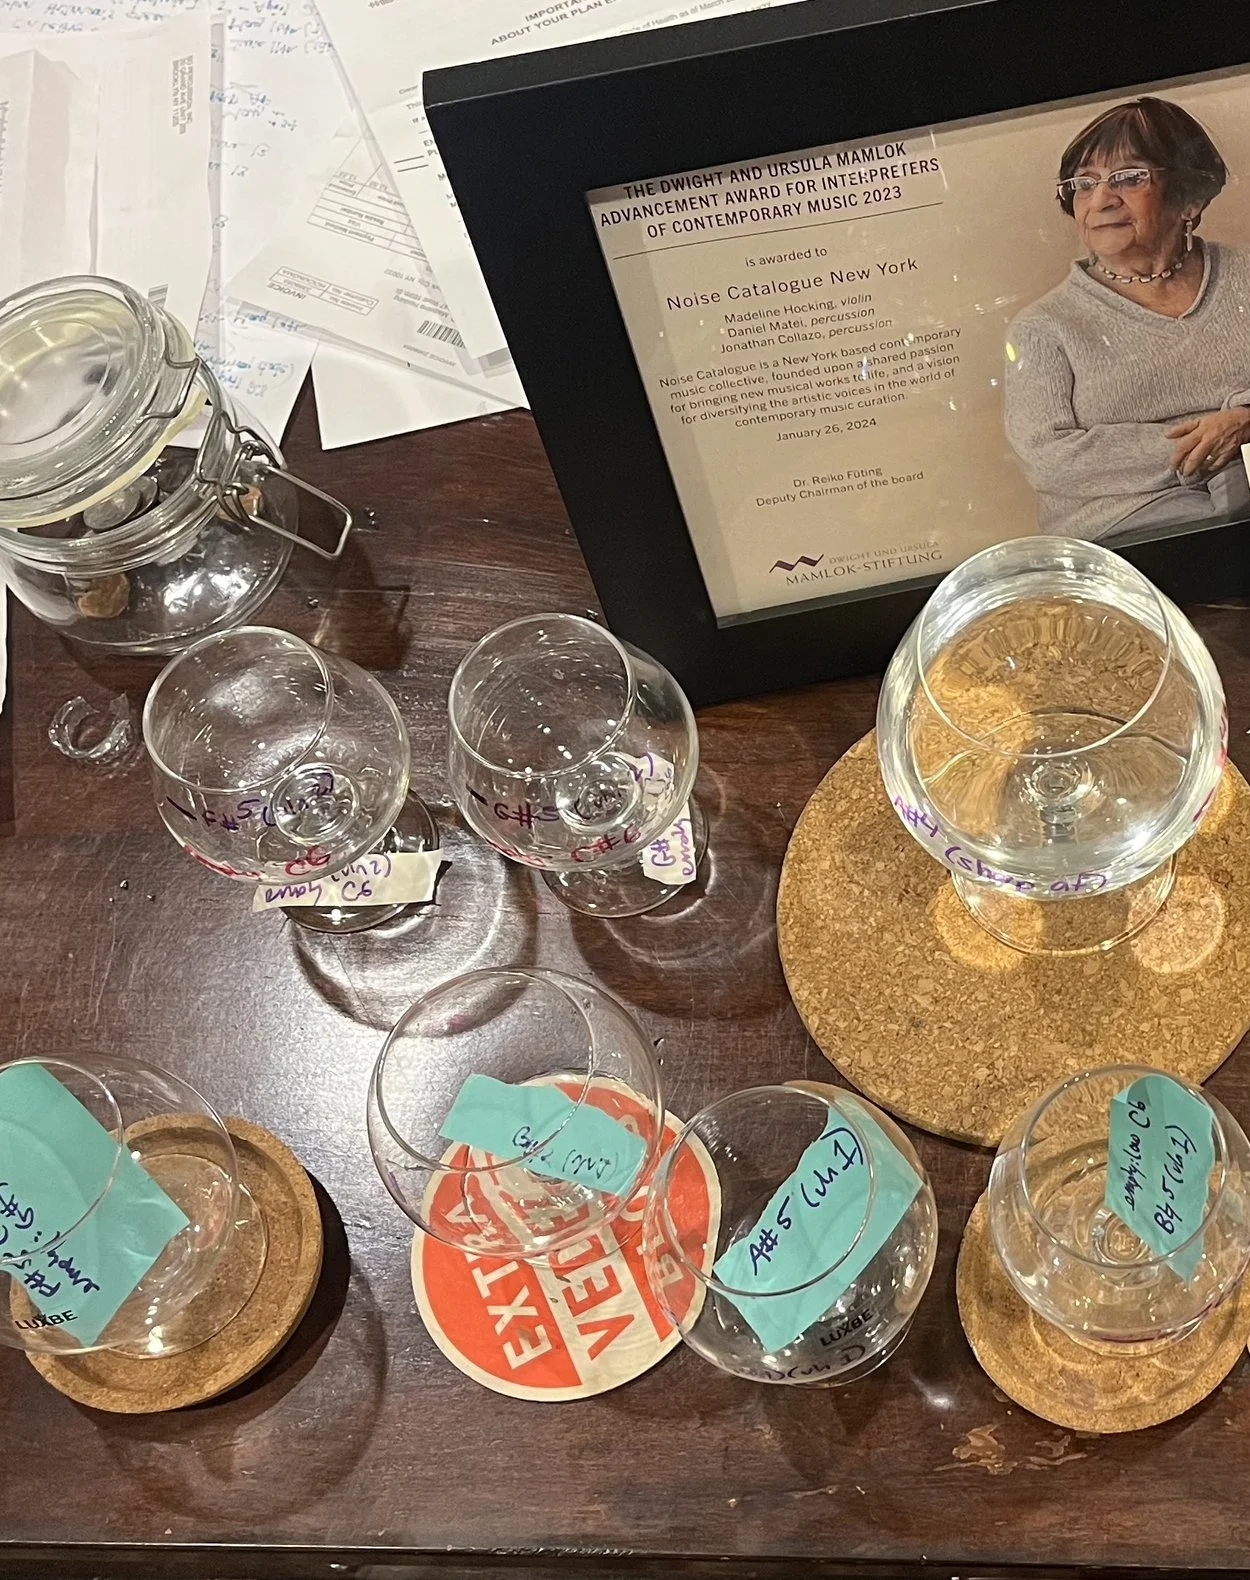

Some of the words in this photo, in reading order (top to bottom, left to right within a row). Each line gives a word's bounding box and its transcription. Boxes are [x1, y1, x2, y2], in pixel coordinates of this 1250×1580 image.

[490, 25, 532, 46] ABOUT
[534, 12, 570, 31] YOUR
[623, 182, 655, 200] THE
[660, 171, 726, 194] DWIGHT
[729, 166, 762, 184] AND
[767, 155, 833, 179] URSULA
[837, 141, 907, 169] MAMLOK
[600, 193, 720, 227] ADVANCEMENT
[724, 184, 781, 207] AWARD
[785, 179, 818, 197] FOR
[821, 158, 941, 190] INTERPRETERS
[647, 222, 667, 239] OF
[672, 201, 804, 235] CONTEMPORARY
[807, 193, 859, 214] MUSIC
[862, 185, 903, 204] 2023
[745, 256, 756, 268] is
[759, 248, 812, 267] awarded
[815, 245, 828, 258] to
[667, 291, 721, 311] Noise
[727, 273, 824, 302] Catalogue
[831, 266, 870, 285] New
[876, 256, 919, 278] York
[724, 306, 781, 324] Madeline
[784, 298, 838, 319] Hocking,
[841, 292, 873, 307] violin
[727, 323, 766, 339] Daniel
[770, 317, 807, 332] Matei,
[811, 306, 876, 328] percussion
[720, 336, 775, 355] Jonathan
[778, 328, 826, 346] Collazo,
[829, 317, 893, 340] percussion
[659, 375, 695, 389] Noise
[696, 362, 757, 383] Catalogue
[759, 359, 770, 371] is
[772, 360, 780, 368] a
[782, 353, 810, 368] New
[811, 348, 839, 362] York
[841, 342, 877, 357] based
[670, 386, 706, 401] music
[709, 375, 769, 394] collective,
[772, 366, 822, 382] founded
[824, 360, 854, 375] upon
[867, 351, 908, 367] shared
[910, 341, 955, 360] passion
[670, 402, 687, 414] for
[689, 392, 738, 411] bringing
[740, 388, 766, 400] new
[767, 379, 813, 396] musical
[816, 372, 851, 388] works
[867, 366, 890, 380] life,
[892, 362, 914, 376] and
[917, 361, 925, 371] a
[927, 353, 961, 369] vision
[681, 412, 697, 425] for
[699, 399, 768, 422] diversifying
[770, 396, 790, 410] the
[792, 391, 833, 407] artistic
[834, 385, 873, 401] voices
[875, 380, 886, 393] in
[888, 376, 907, 390] the
[909, 371, 943, 387] world
[944, 367, 957, 380] of
[734, 407, 816, 429] contemporary
[819, 399, 855, 415] music
[857, 389, 907, 409] curation.
[776, 426, 822, 443] January
[824, 422, 844, 437] 26,
[846, 417, 878, 431] 2024
[756, 491, 797, 507] Deputy
[799, 482, 854, 500] Chairman
[857, 478, 868, 491] of
[870, 475, 889, 489] the
[891, 470, 925, 486] board
[793, 477, 810, 489] Dr.
[812, 471, 844, 486] Reiko
[785, 549, 943, 587] MAMLOK-STIFTUNG
[829, 549, 872, 565] DWIGHT
[873, 546, 899, 559] UND
[340, 879, 374, 901] C6
[14, 1309, 78, 1330] LUXBE
[819, 1308, 875, 1348] LUXBE
